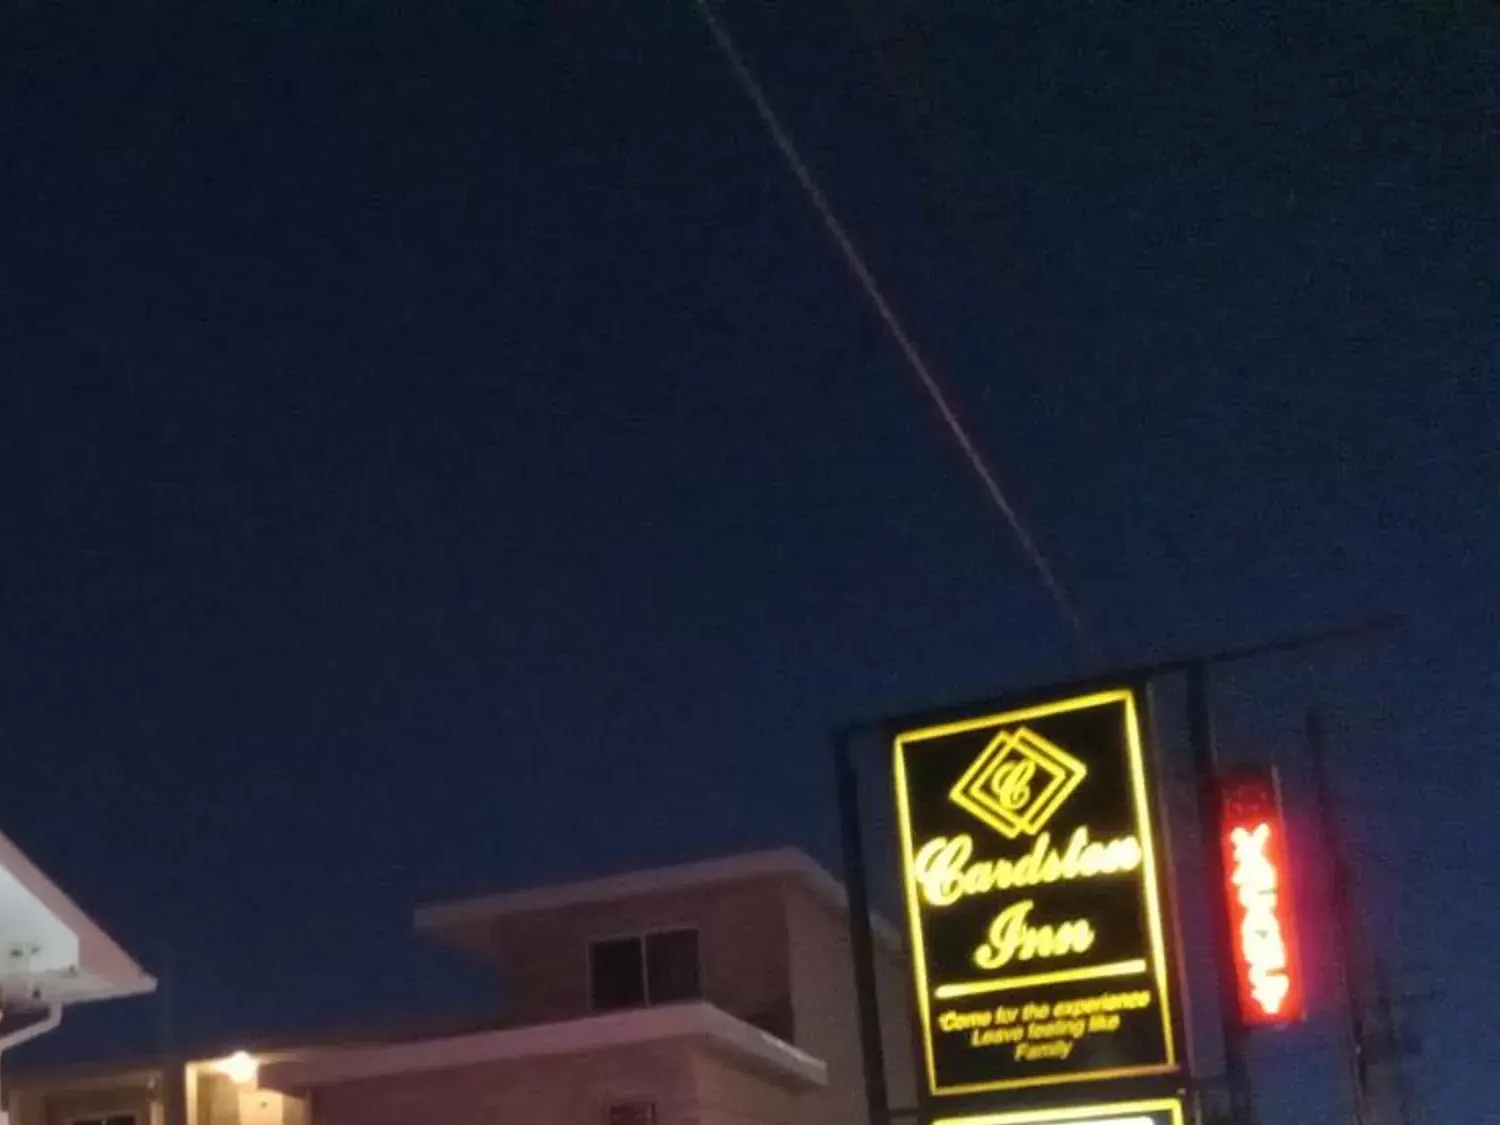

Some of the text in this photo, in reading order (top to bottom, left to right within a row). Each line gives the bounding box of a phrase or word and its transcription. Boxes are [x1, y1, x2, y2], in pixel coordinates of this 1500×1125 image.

[972, 899, 1096, 970] Inn
[994, 1005, 1019, 1026] for
[1021, 1000, 1050, 1023] the
[1052, 989, 1151, 1018] experience
[970, 1026, 1025, 1048] Leave
[1013, 1038, 1073, 1063] Family
